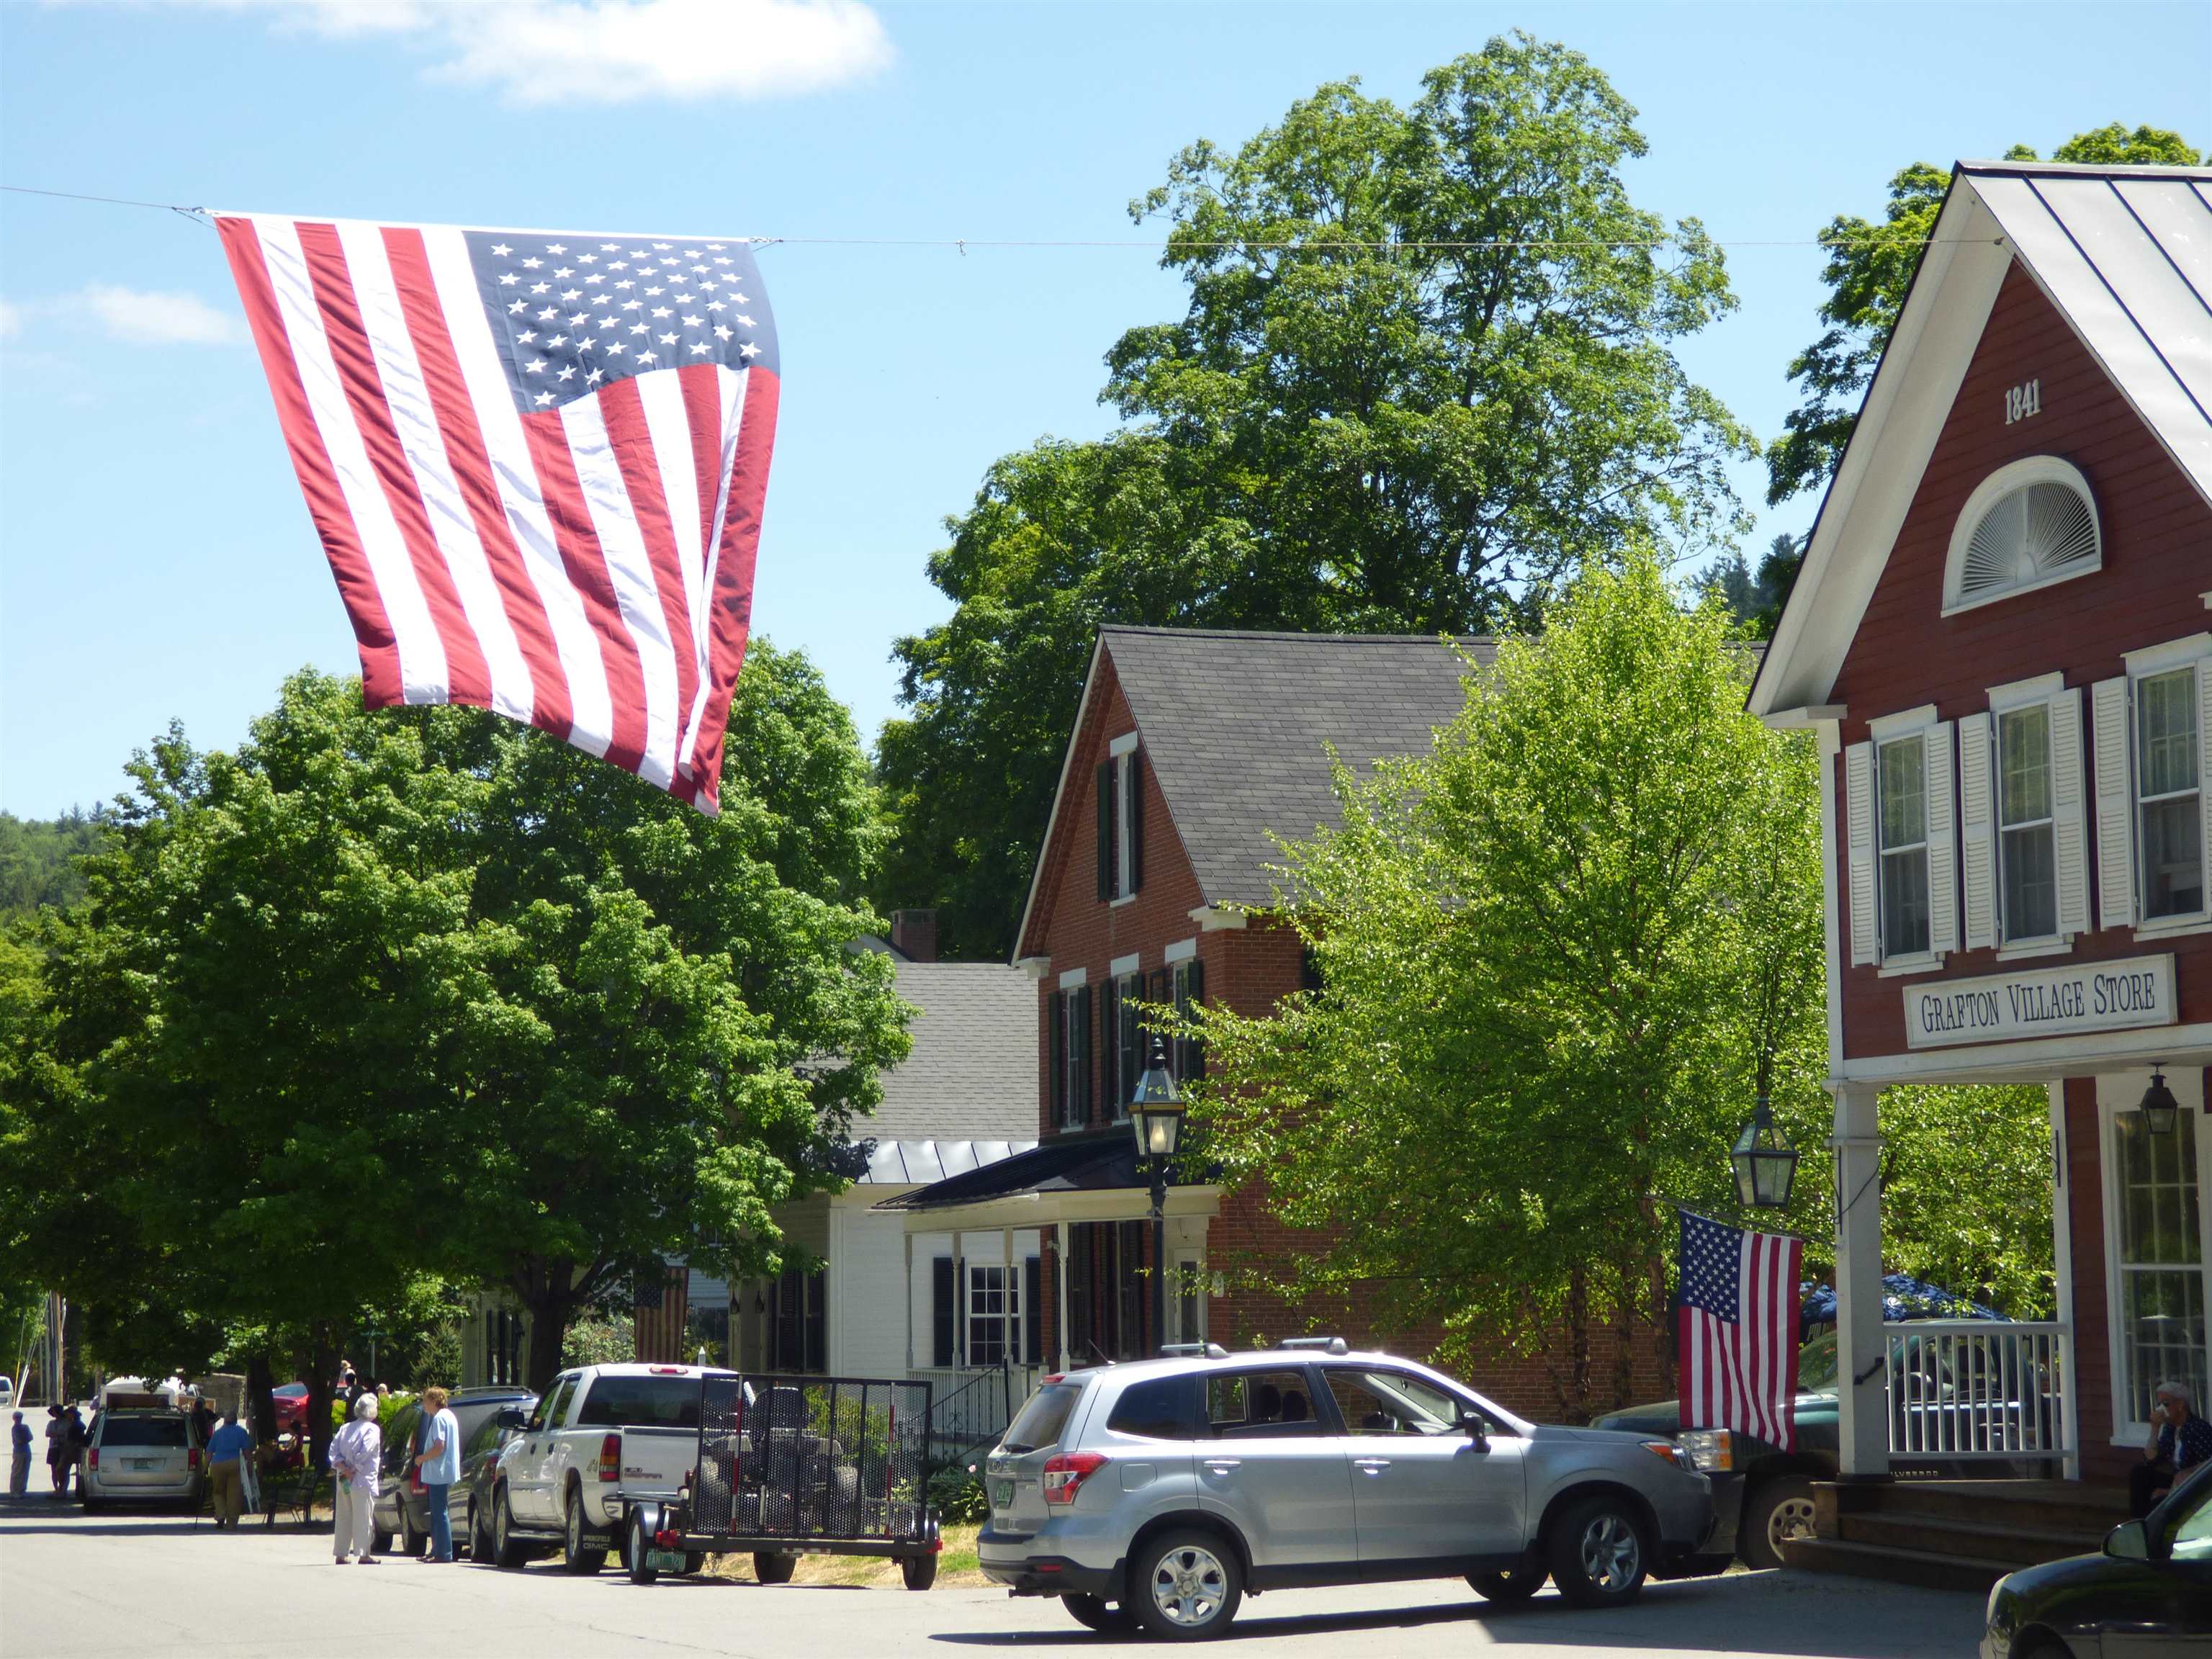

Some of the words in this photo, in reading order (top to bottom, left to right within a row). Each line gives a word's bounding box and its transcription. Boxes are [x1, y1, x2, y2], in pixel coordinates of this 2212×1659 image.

[2005, 379, 2041, 425] 1841
[1922, 990, 2000, 1033] GRAFTON
[2007, 980, 2085, 1022] VILLAGE
[2094, 972, 2155, 1015] STORE
